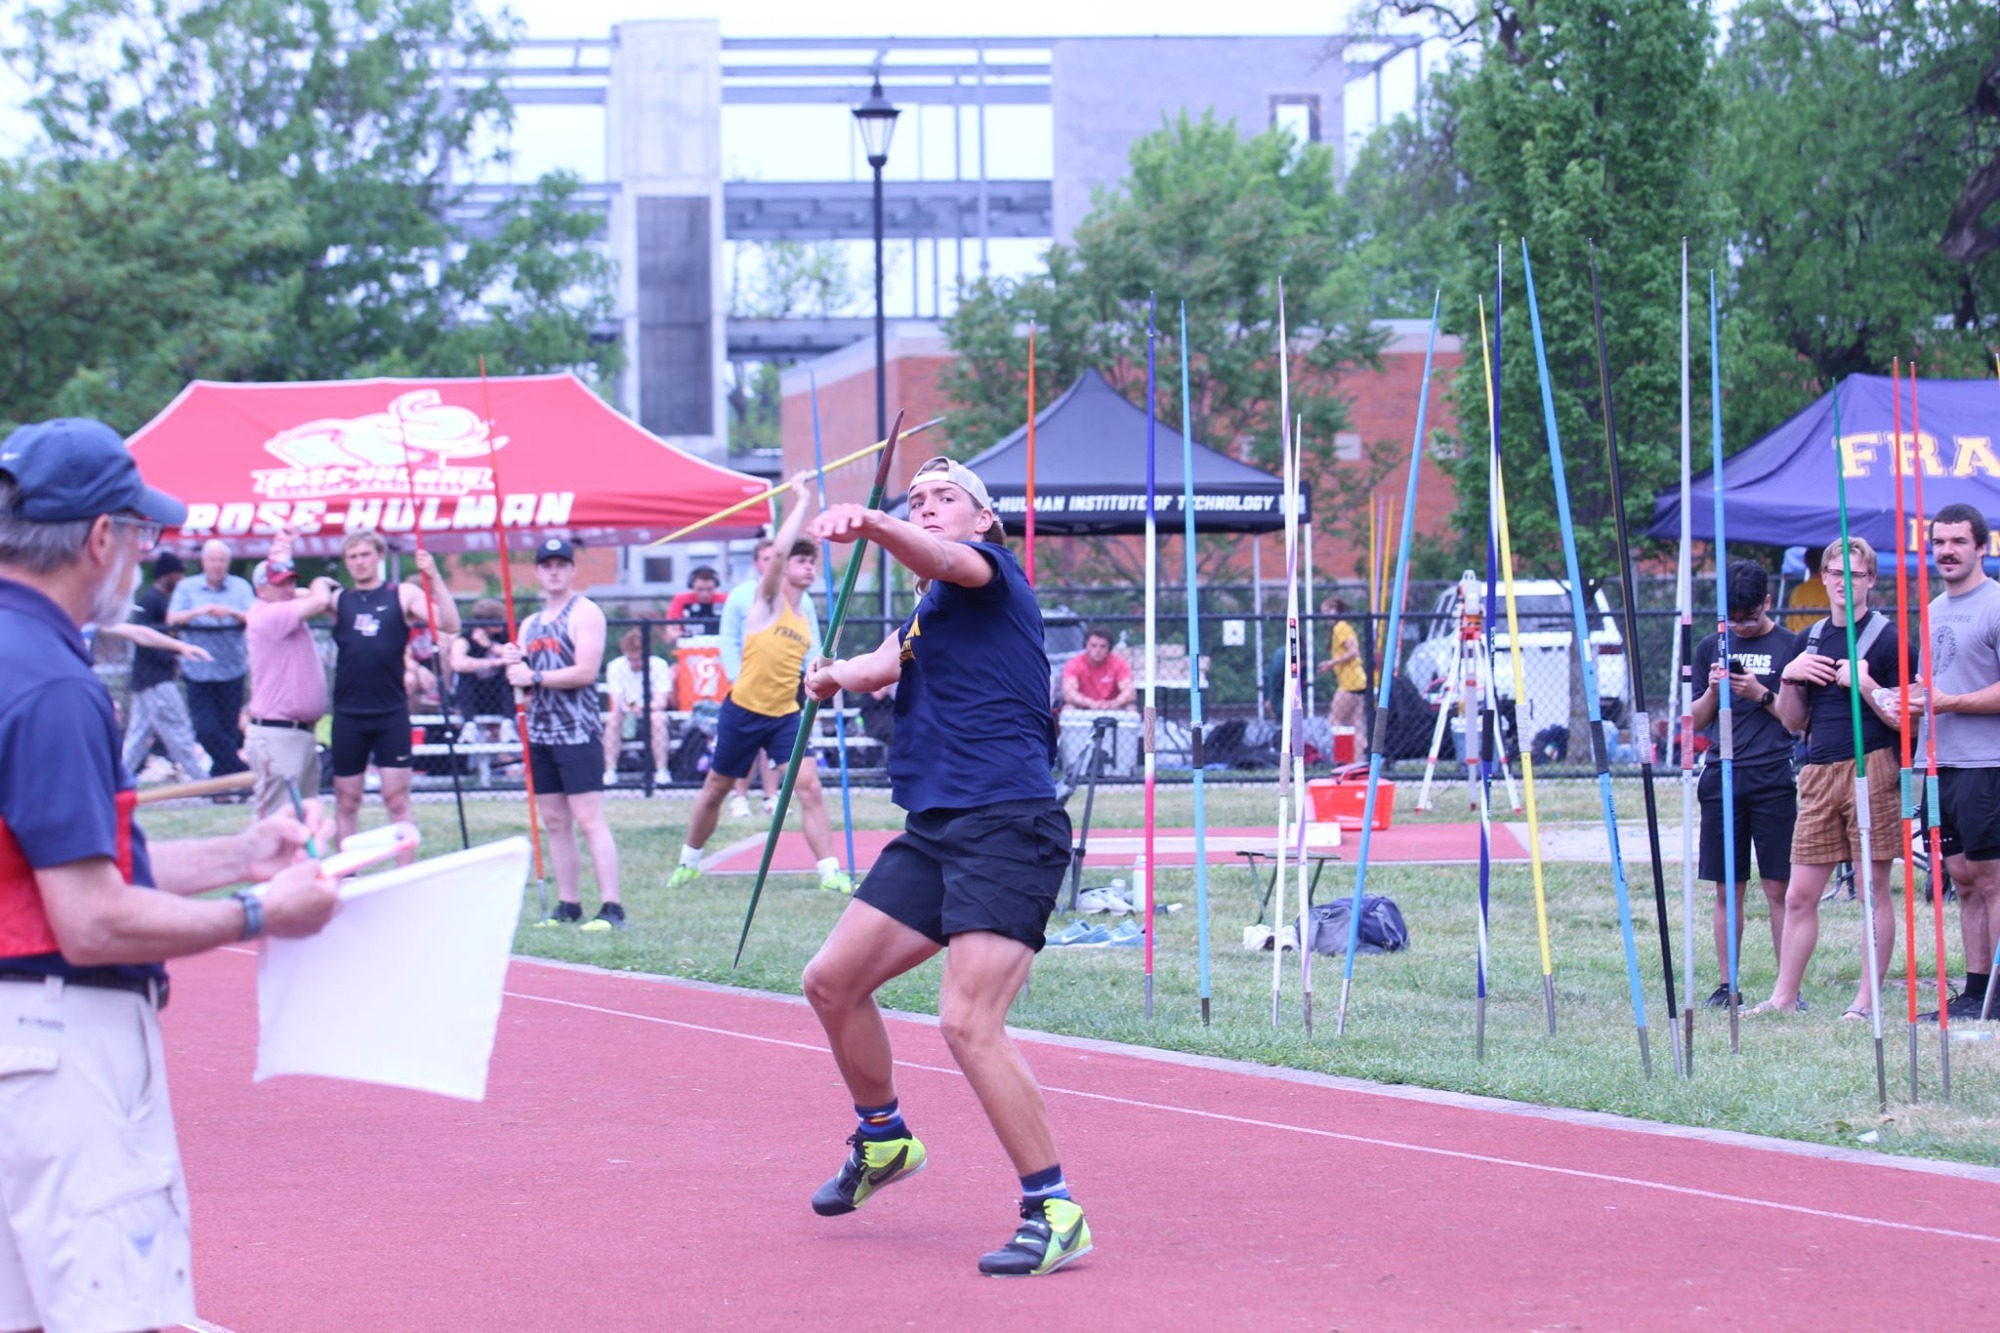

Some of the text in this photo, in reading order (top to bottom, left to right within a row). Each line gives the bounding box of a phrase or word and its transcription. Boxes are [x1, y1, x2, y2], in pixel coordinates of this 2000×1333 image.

[184, 492, 574, 536] ROSE-HULMAN
[1068, 494, 1147, 512] INSTITUTE
[1153, 494, 1170, 511] OF
[1177, 494, 1274, 511] TCHNOLOGY
